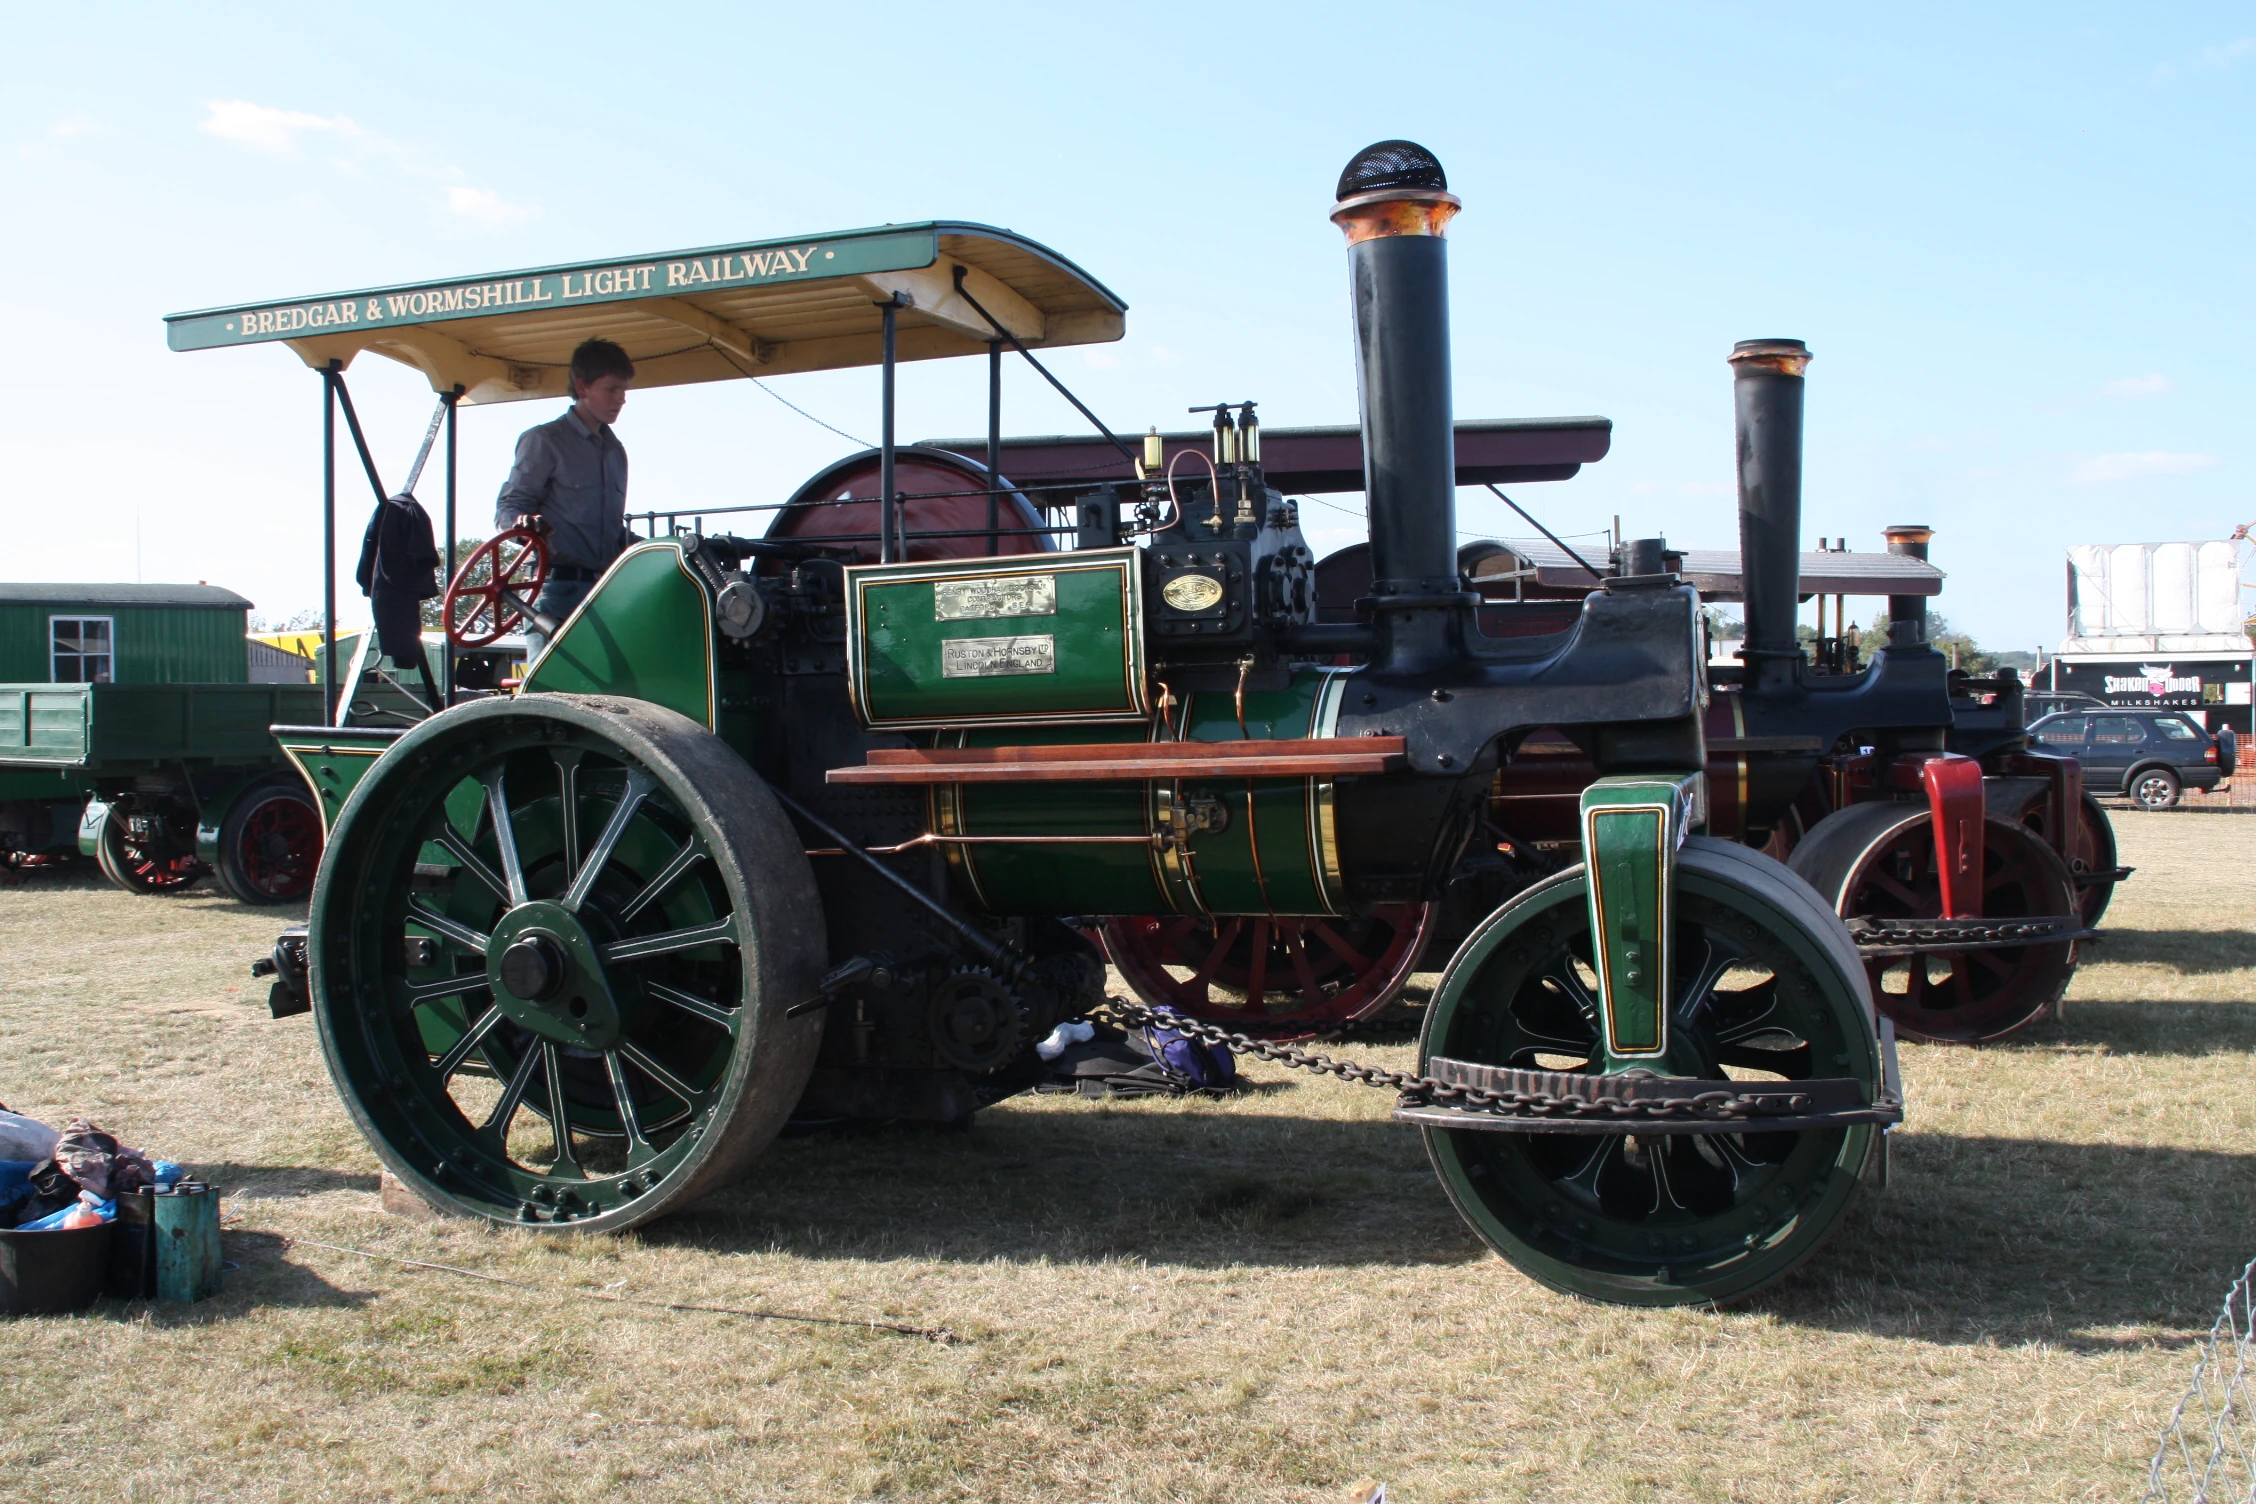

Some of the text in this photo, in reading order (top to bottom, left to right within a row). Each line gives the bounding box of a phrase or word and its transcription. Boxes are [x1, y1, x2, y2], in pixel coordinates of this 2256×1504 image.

[241, 247, 817, 336] BREDGAR & WORMSHILL LIGHT RAILWAY
[947, 648, 984, 659] RUSTON
[987, 649, 993, 658] &
[993, 646, 1037, 658] HORNSBY
[956, 658, 1043, 671] LINCOLN ENGLAND
